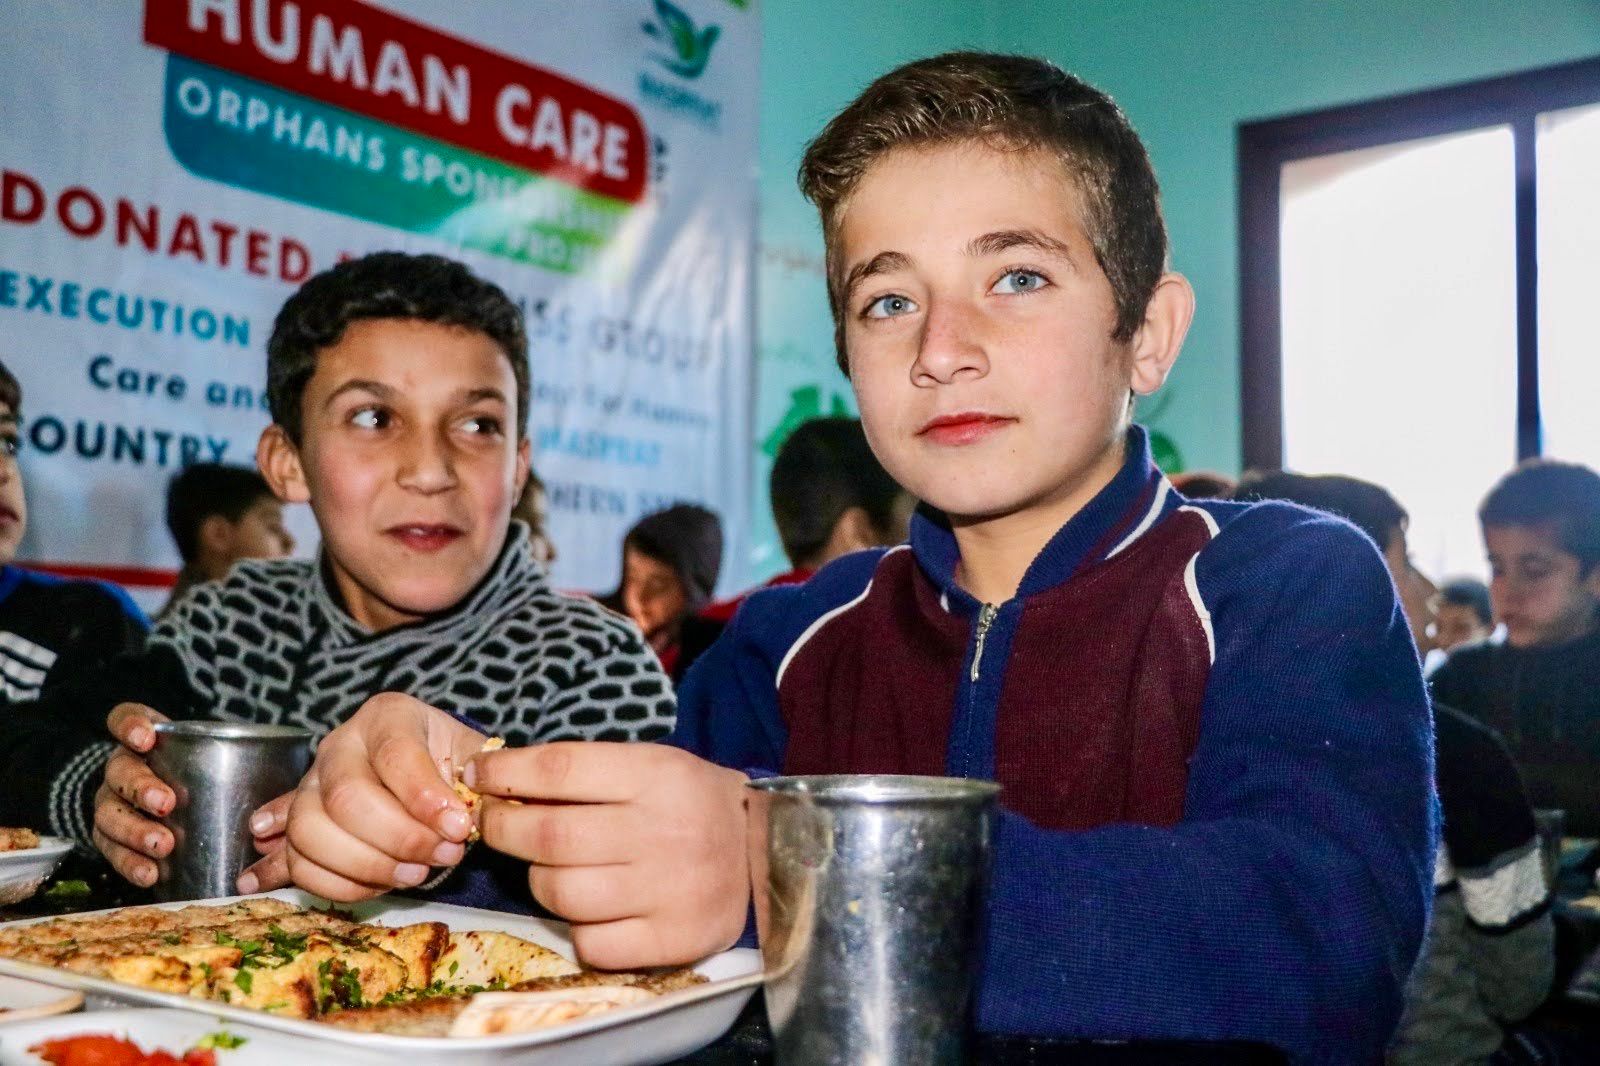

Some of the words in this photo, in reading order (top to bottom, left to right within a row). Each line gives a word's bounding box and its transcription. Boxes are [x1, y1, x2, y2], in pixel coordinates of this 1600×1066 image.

[178, 77, 386, 172] ORPHANS
[494, 83, 630, 182] CARE
[1, 168, 312, 286] DONATED
[0, 269, 251, 348] EXECUTION
[89, 354, 187, 400] Care
[27, 414, 230, 468] OUNTRY
